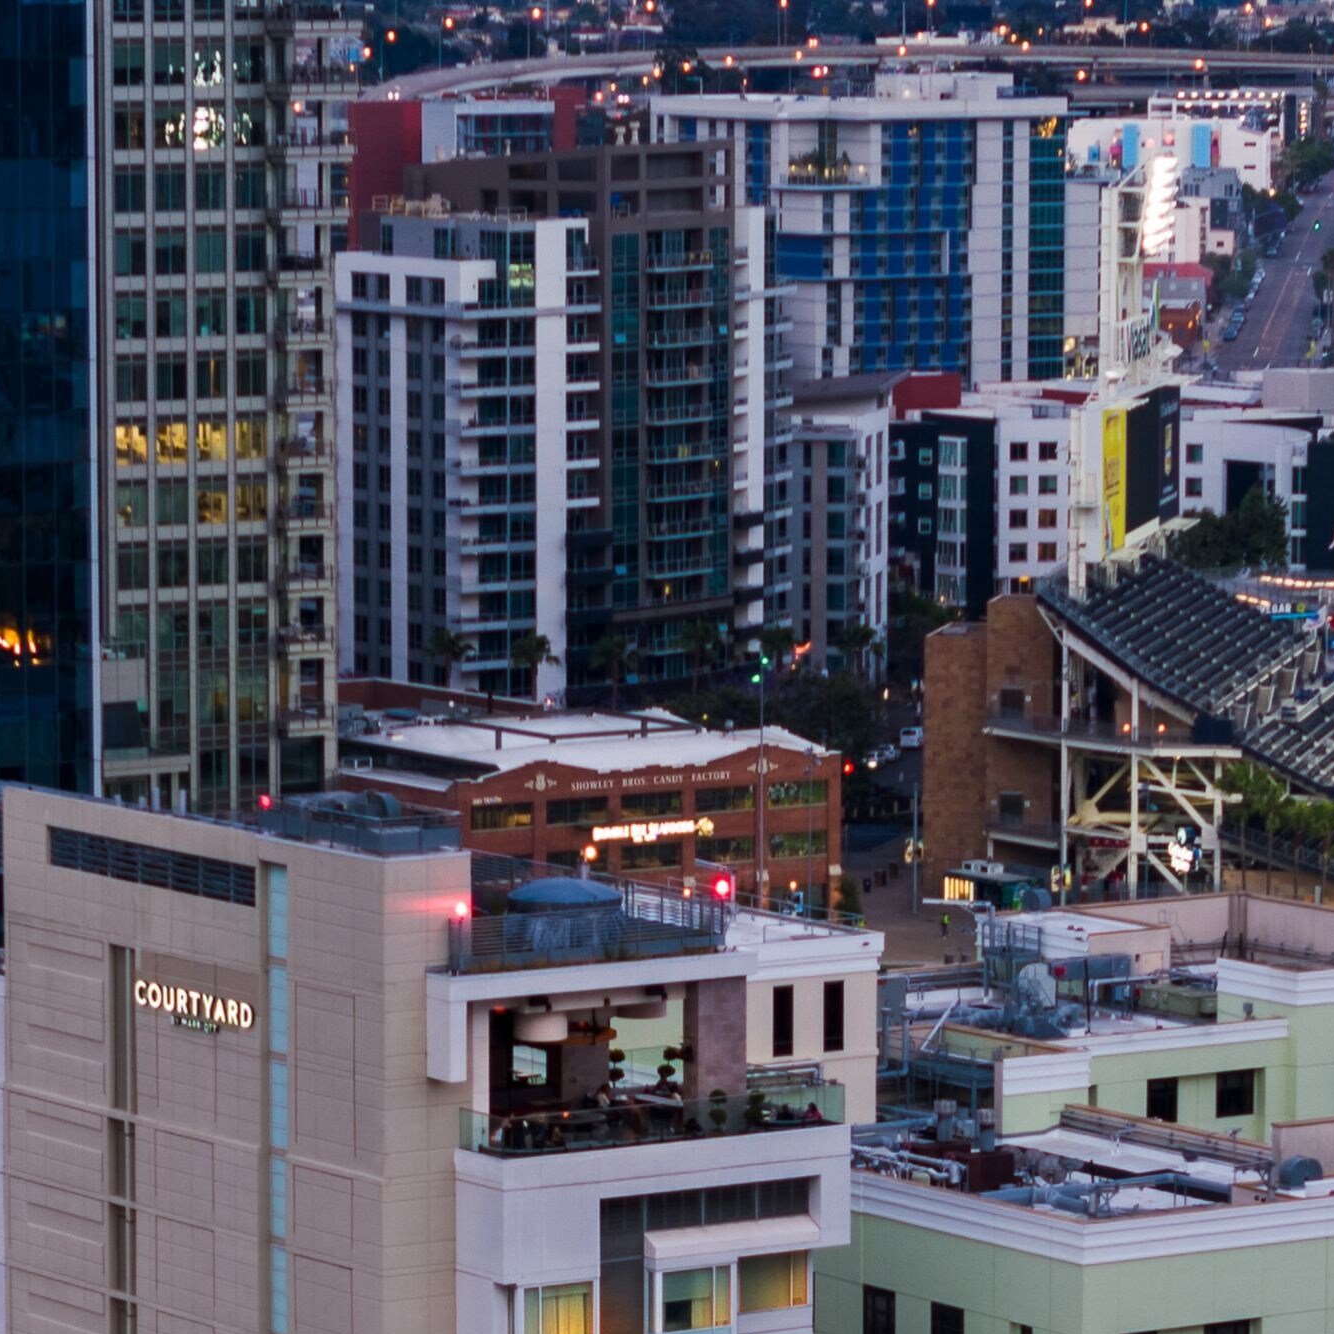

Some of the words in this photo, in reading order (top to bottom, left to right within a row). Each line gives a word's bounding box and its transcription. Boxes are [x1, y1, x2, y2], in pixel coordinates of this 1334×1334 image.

[570, 779, 614, 791] SHOWLEY
[653, 775, 684, 785] CANDY
[692, 771, 730, 782] FACTORY
[134, 979, 254, 1029] COURTYARD
